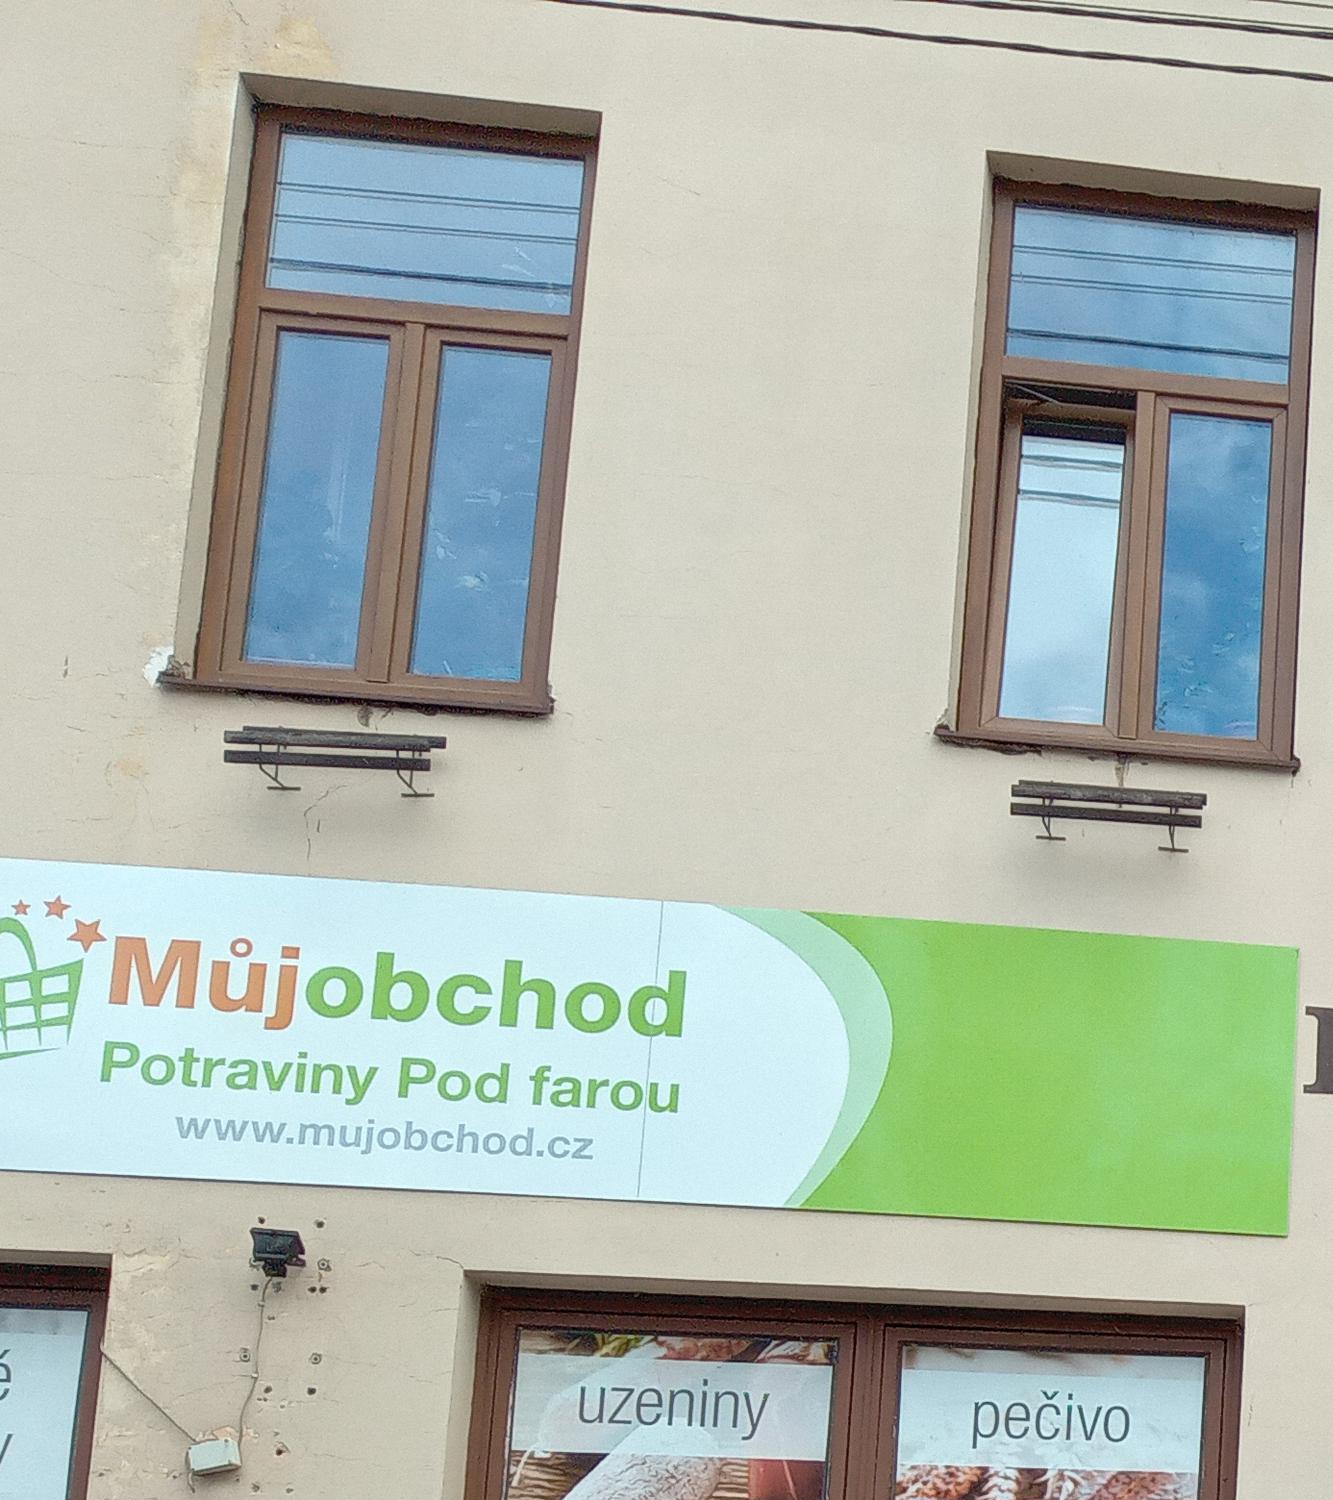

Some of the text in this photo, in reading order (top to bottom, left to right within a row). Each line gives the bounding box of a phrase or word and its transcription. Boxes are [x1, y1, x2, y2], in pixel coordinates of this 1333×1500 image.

[107, 934, 688, 1038] Můjobchod
[99, 1040, 682, 1115] Potraviny Pod farou
[174, 1113, 595, 1162] www.mujobchod.cz
[577, 1378, 771, 1441] uzeniny
[970, 1390, 1132, 1450] pečivo
